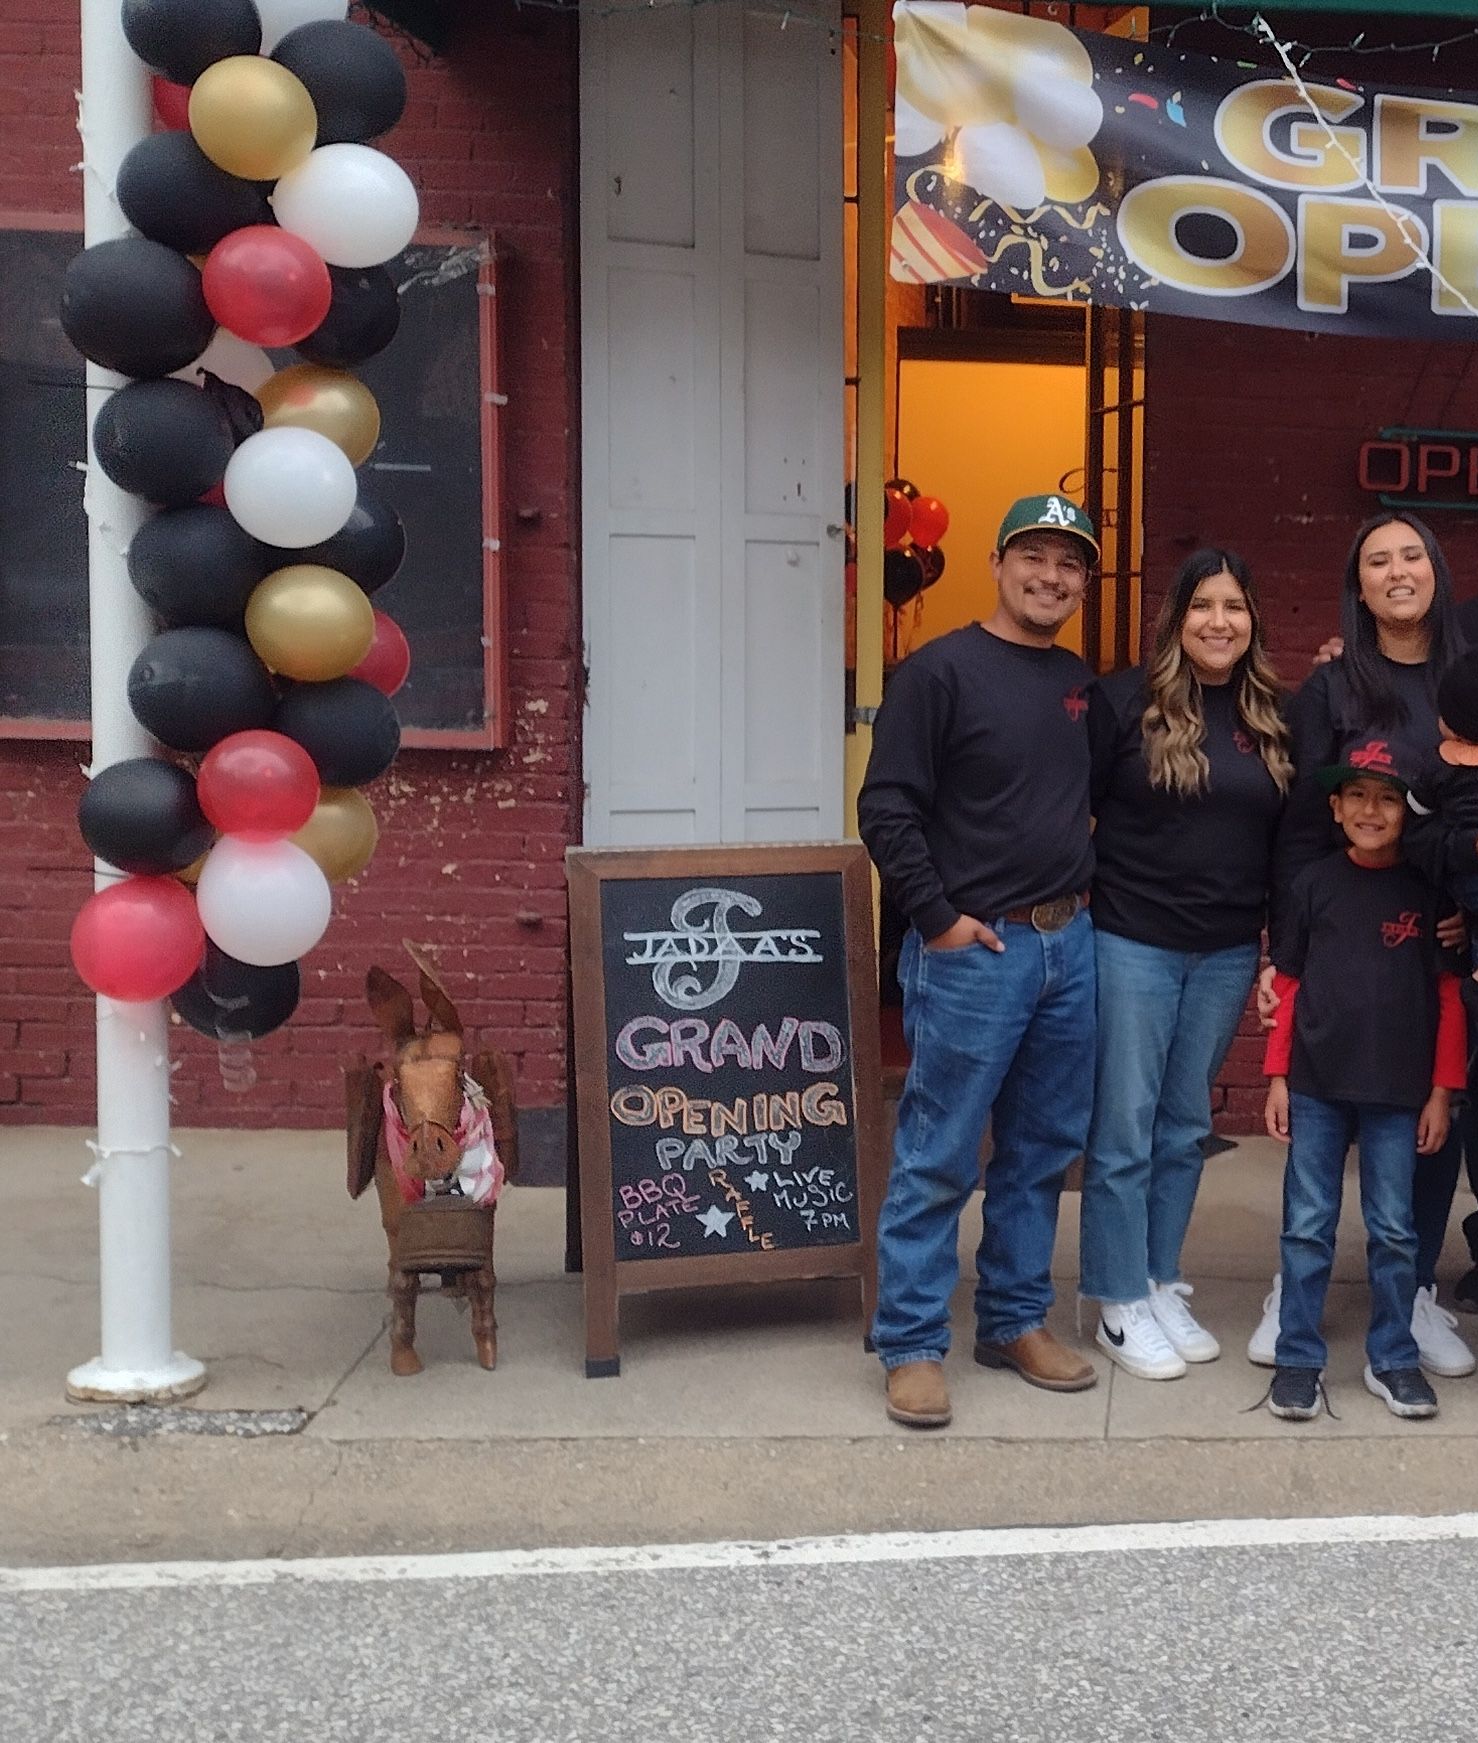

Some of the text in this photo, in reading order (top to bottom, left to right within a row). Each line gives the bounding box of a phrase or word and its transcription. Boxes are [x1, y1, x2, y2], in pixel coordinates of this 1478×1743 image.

[615, 1015, 846, 1074] GRAND
[610, 1082, 848, 1138] OPENING
[655, 1131, 801, 1170] PARTY
[618, 1173, 700, 1209] BBQ
[773, 1166, 835, 1188] LIVE
[617, 1200, 700, 1229] PLATE
[708, 1169, 776, 1250] RAFFLE
[773, 1182, 853, 1210] MUSIC
